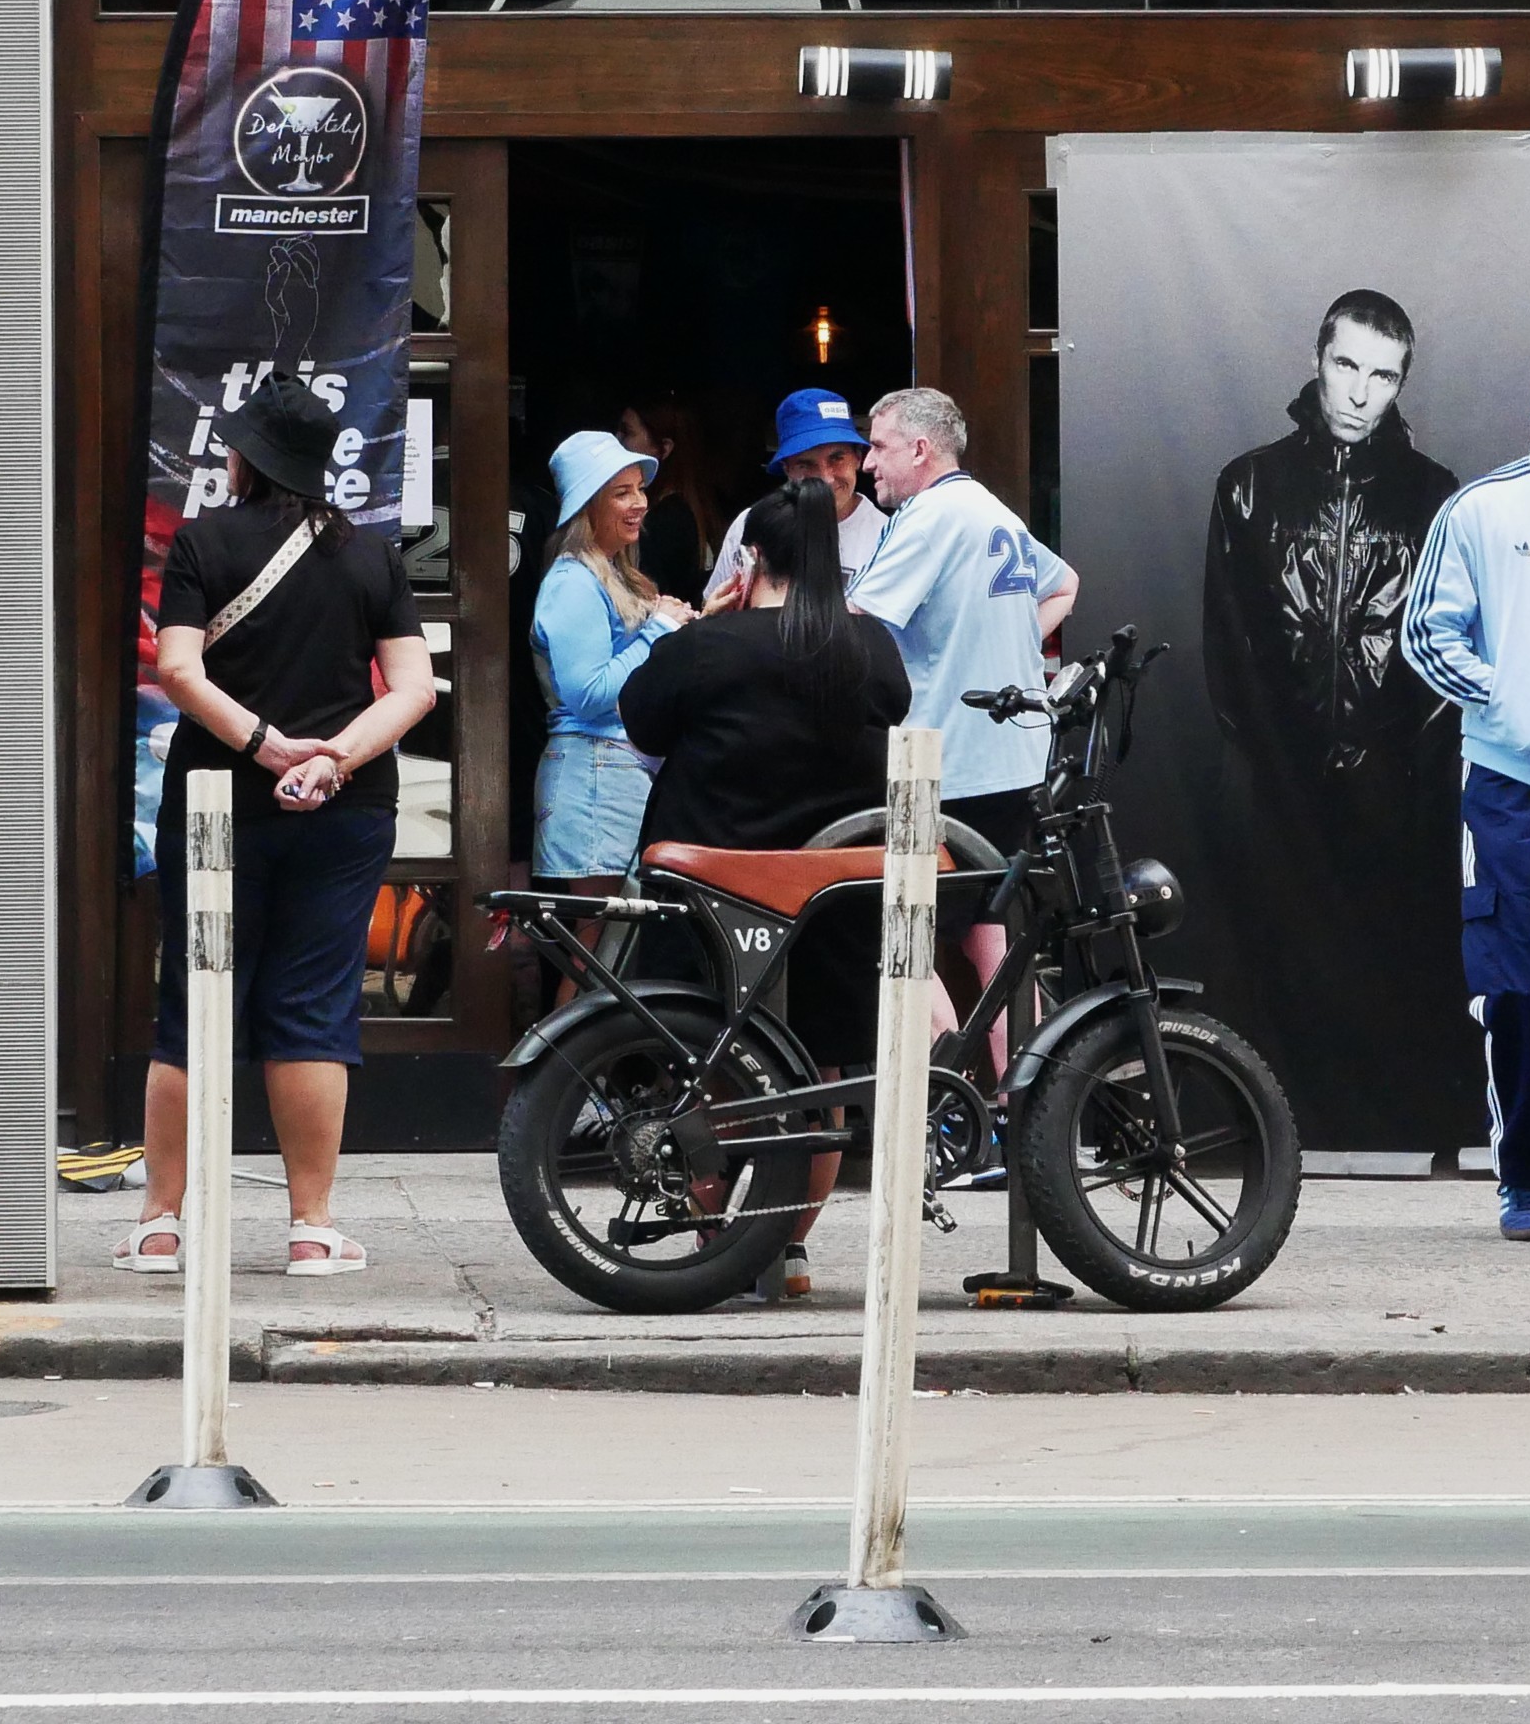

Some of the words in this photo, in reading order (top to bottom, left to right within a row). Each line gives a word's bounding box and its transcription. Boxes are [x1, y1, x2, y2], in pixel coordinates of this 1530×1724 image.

[230, 207, 358, 224] manchester
[734, 927, 772, 952] V8
[1128, 1256, 1242, 1288] KENDA
